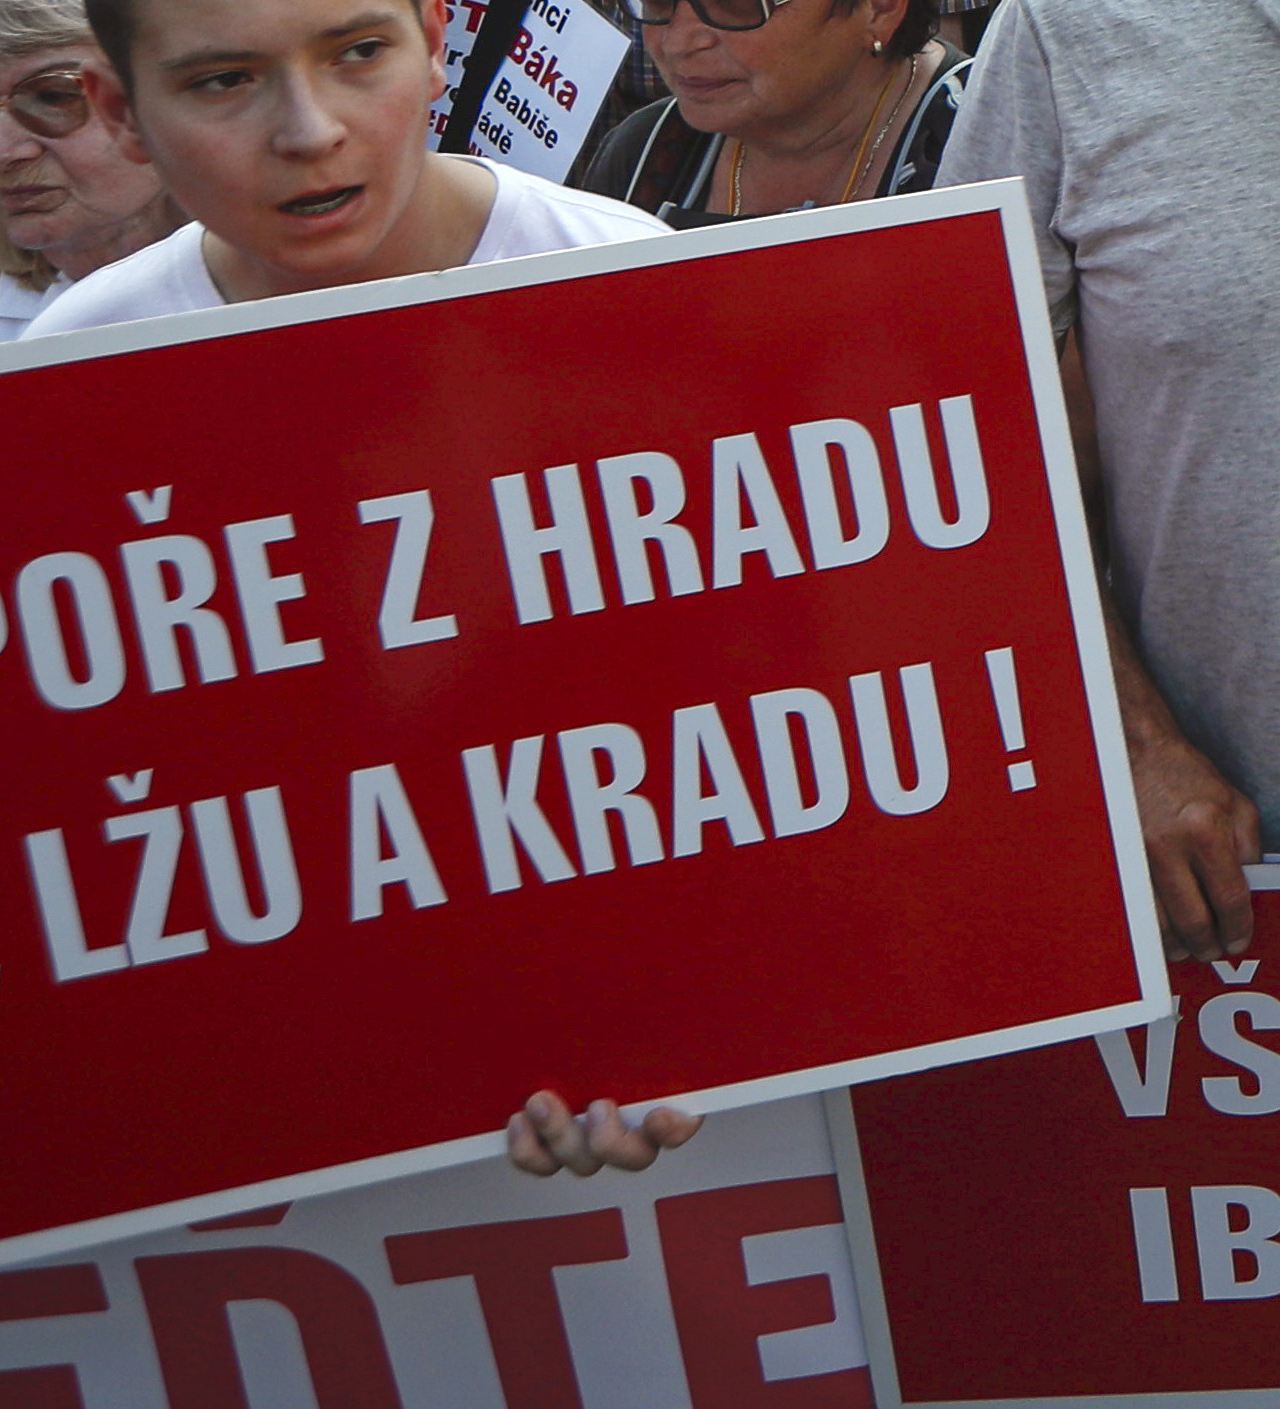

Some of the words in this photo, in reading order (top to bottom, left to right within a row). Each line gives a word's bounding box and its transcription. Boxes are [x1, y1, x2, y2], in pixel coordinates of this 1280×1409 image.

[474, 111, 514, 156] ádě
[494, 77, 559, 150] Babiše
[0, 483, 325, 713] OŘE
[358, 488, 461, 652] Z
[490, 393, 992, 627] HRADU
[20, 768, 304, 985] LŽU
[348, 763, 448, 924] A
[461, 661, 952, 896] KRADU
[984, 646, 1038, 794] !
